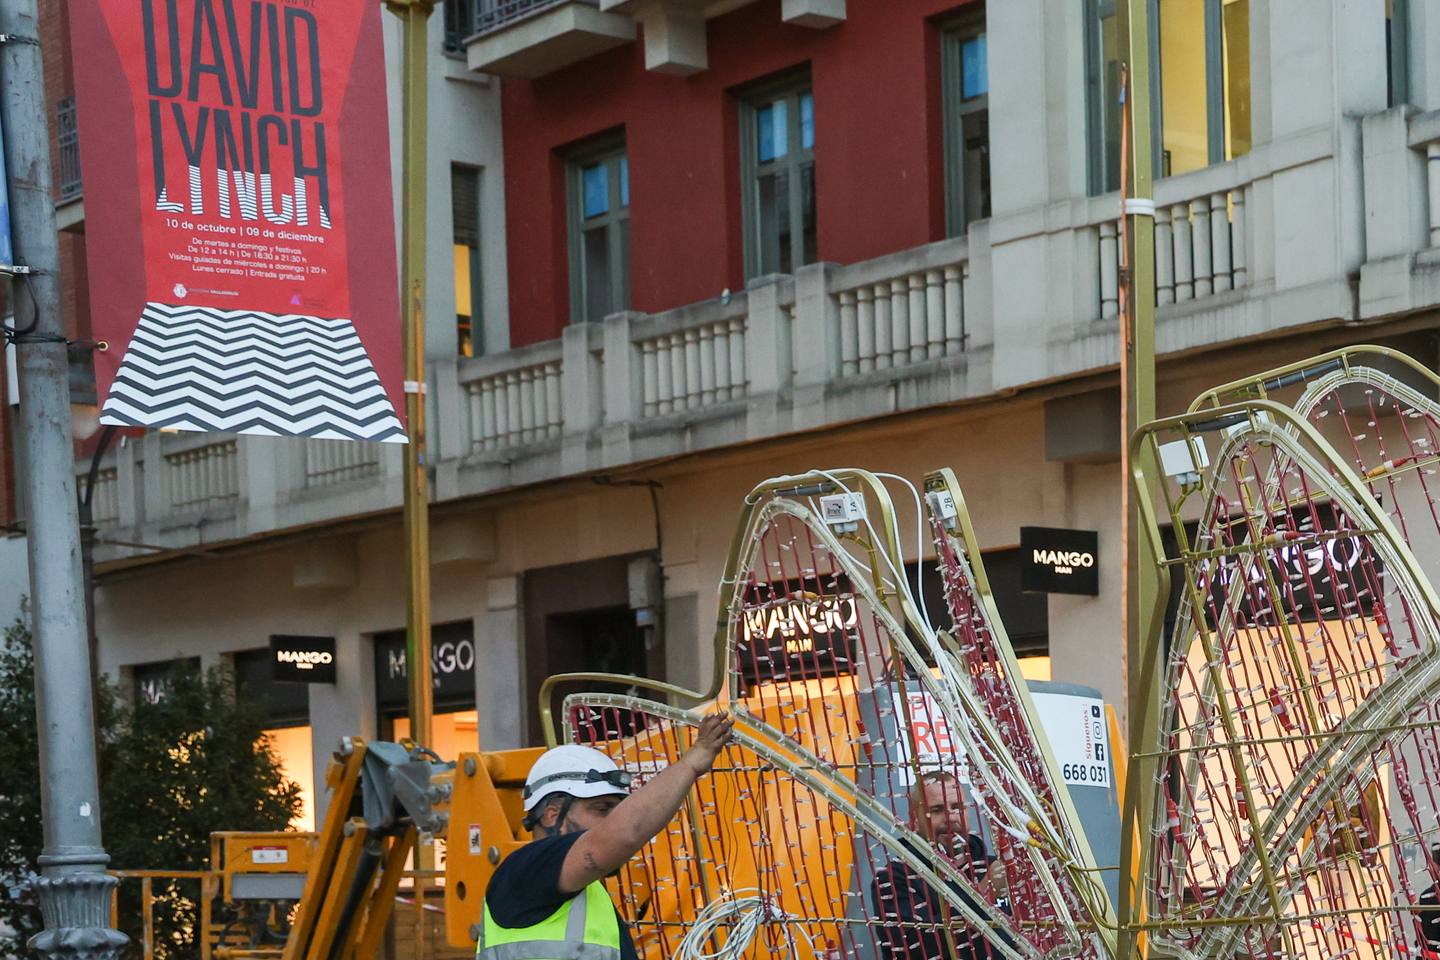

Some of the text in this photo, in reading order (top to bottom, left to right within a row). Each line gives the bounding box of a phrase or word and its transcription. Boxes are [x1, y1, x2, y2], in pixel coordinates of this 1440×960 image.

[141, 0, 323, 117] DAVID
[150, 100, 332, 229] LYNCH
[166, 218, 179, 228] 10
[181, 221, 194, 230] de
[197, 223, 237, 234] octubre
[246, 227, 260, 236] 09
[263, 229, 275, 238] de
[277, 231, 325, 243] diciembre
[1033, 549, 1094, 568] MANGO
[743, 598, 857, 642] MANGO
[277, 651, 333, 664] MANGO
[1063, 763, 1107, 783] 668 031
